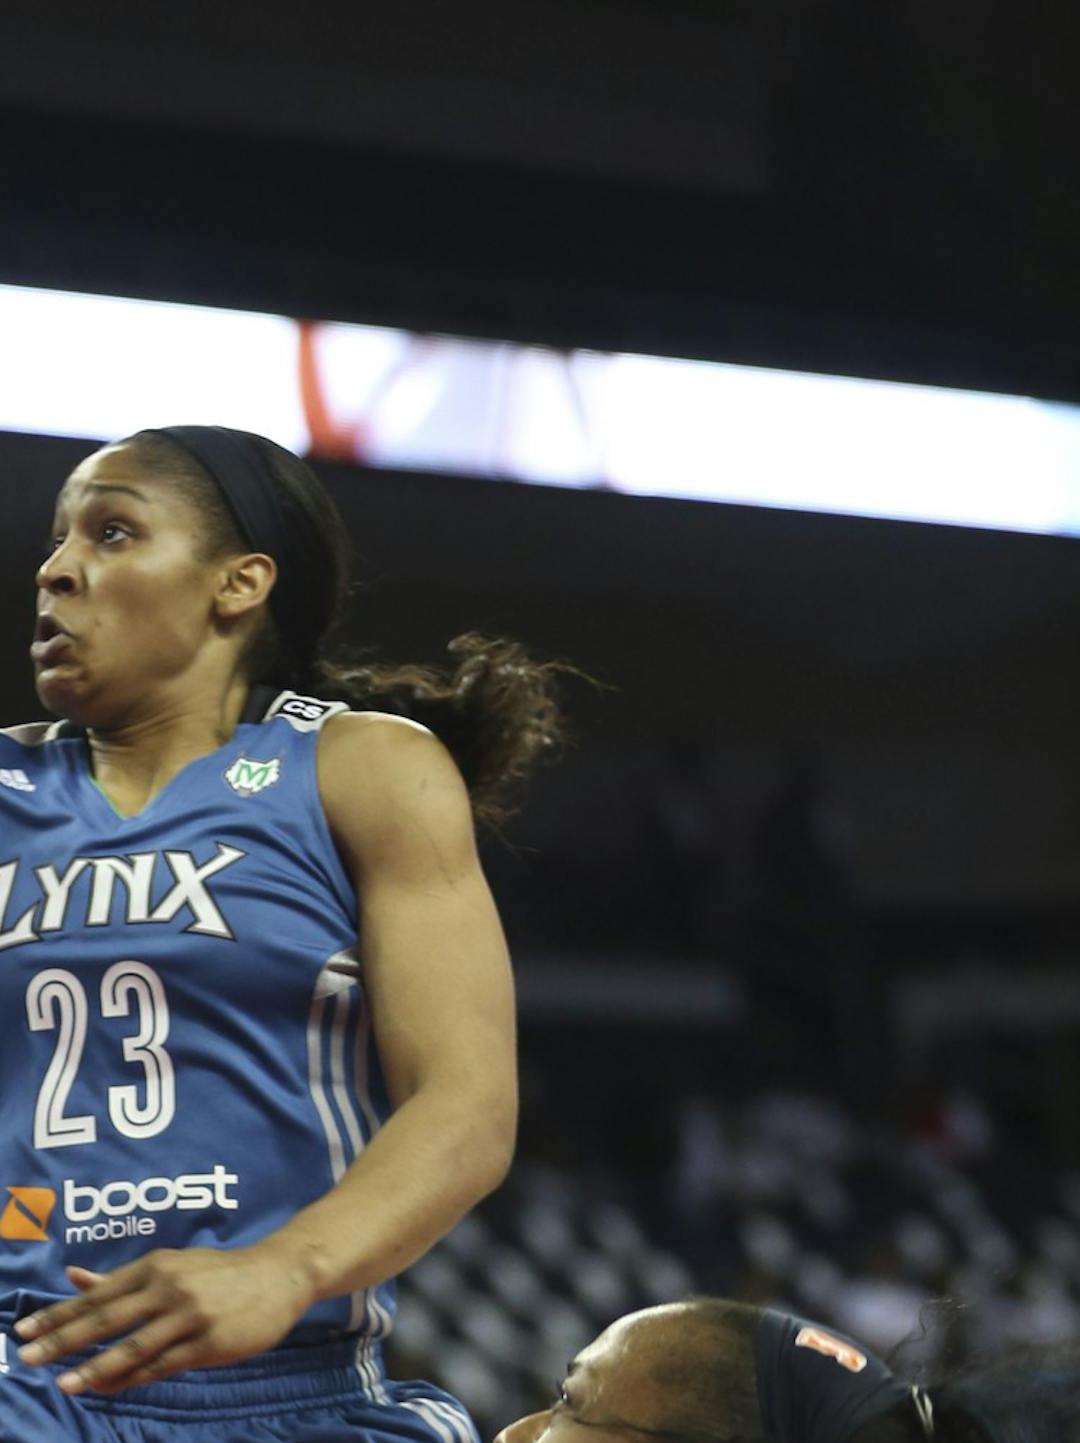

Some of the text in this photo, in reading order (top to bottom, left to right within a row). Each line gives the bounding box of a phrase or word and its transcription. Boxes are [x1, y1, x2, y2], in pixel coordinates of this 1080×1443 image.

[25, 960, 177, 1150] 23
[63, 1165, 239, 1222] boost
[65, 1216, 157, 1244] mobile
